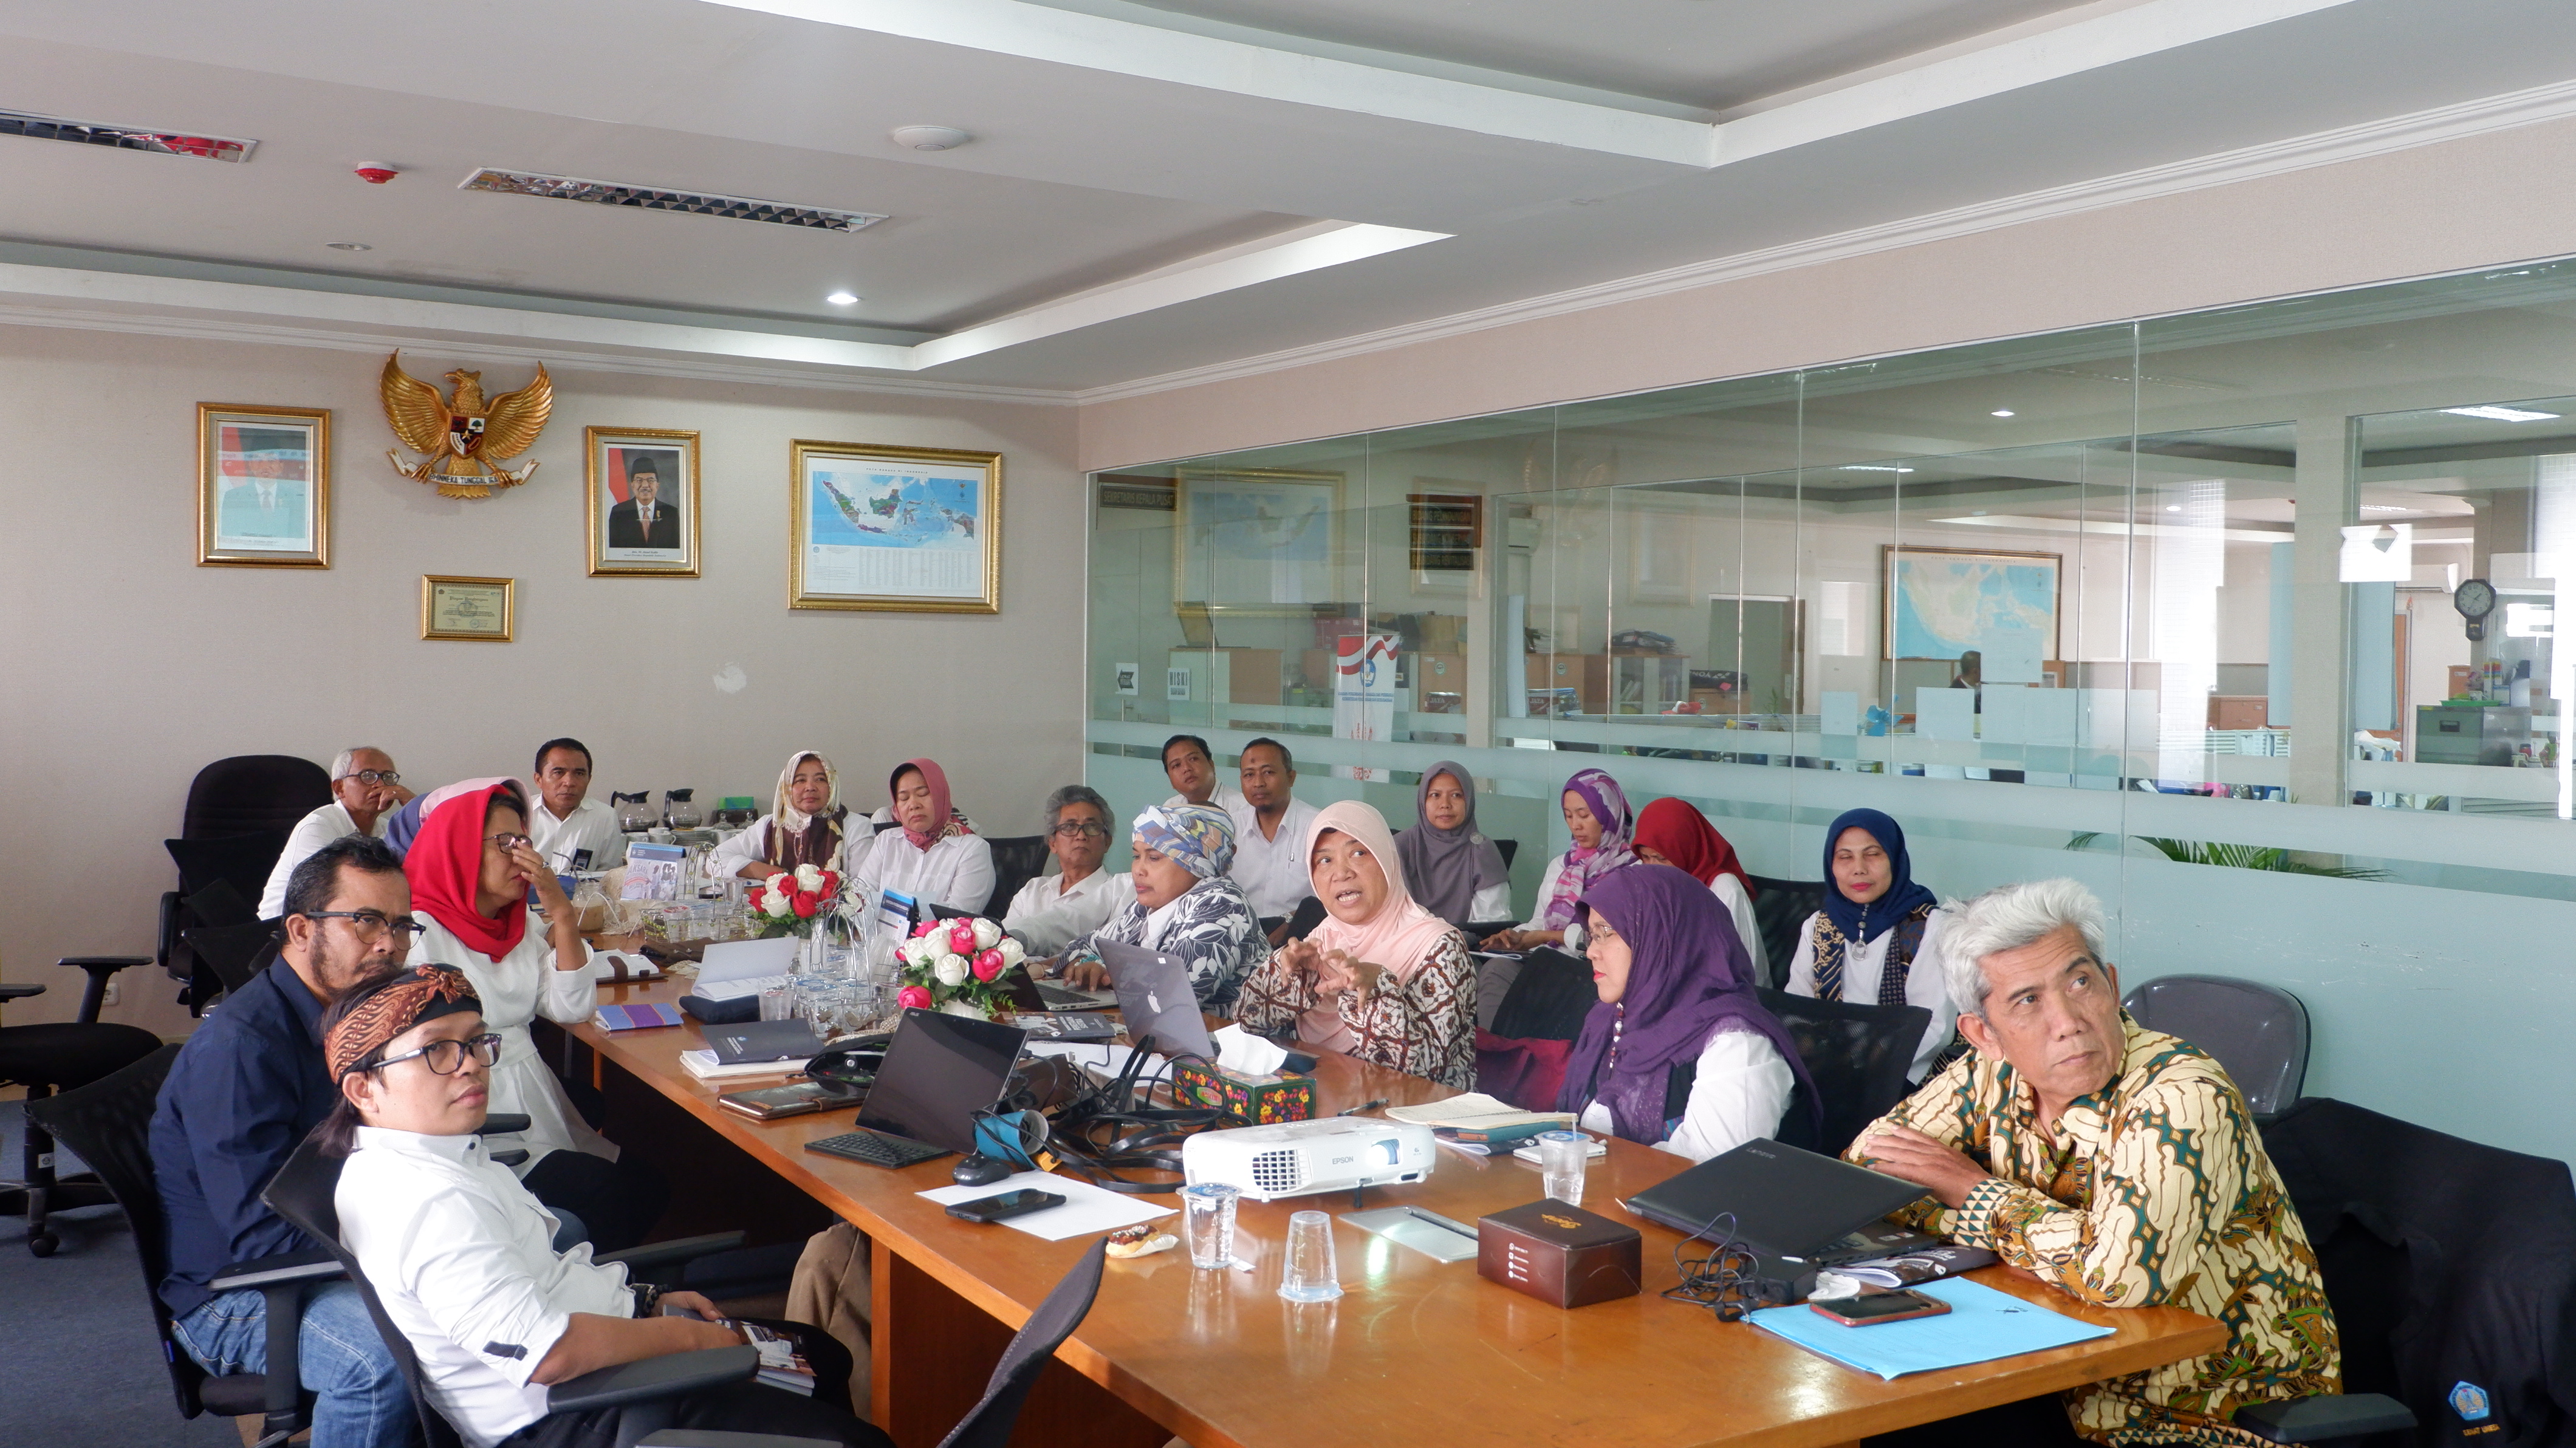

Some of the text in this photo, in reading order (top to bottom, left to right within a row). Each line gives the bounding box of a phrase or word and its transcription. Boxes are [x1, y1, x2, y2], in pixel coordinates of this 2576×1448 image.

[429, 473, 458, 483] BHINNEKA
[1104, 490, 1174, 506] SEKRETARIS KEPALA PUSAT
[1170, 672, 1188, 686] HISKI
[1745, 1147, 1776, 1159] Lenovo
[1332, 1156, 1354, 1165] EPSON
